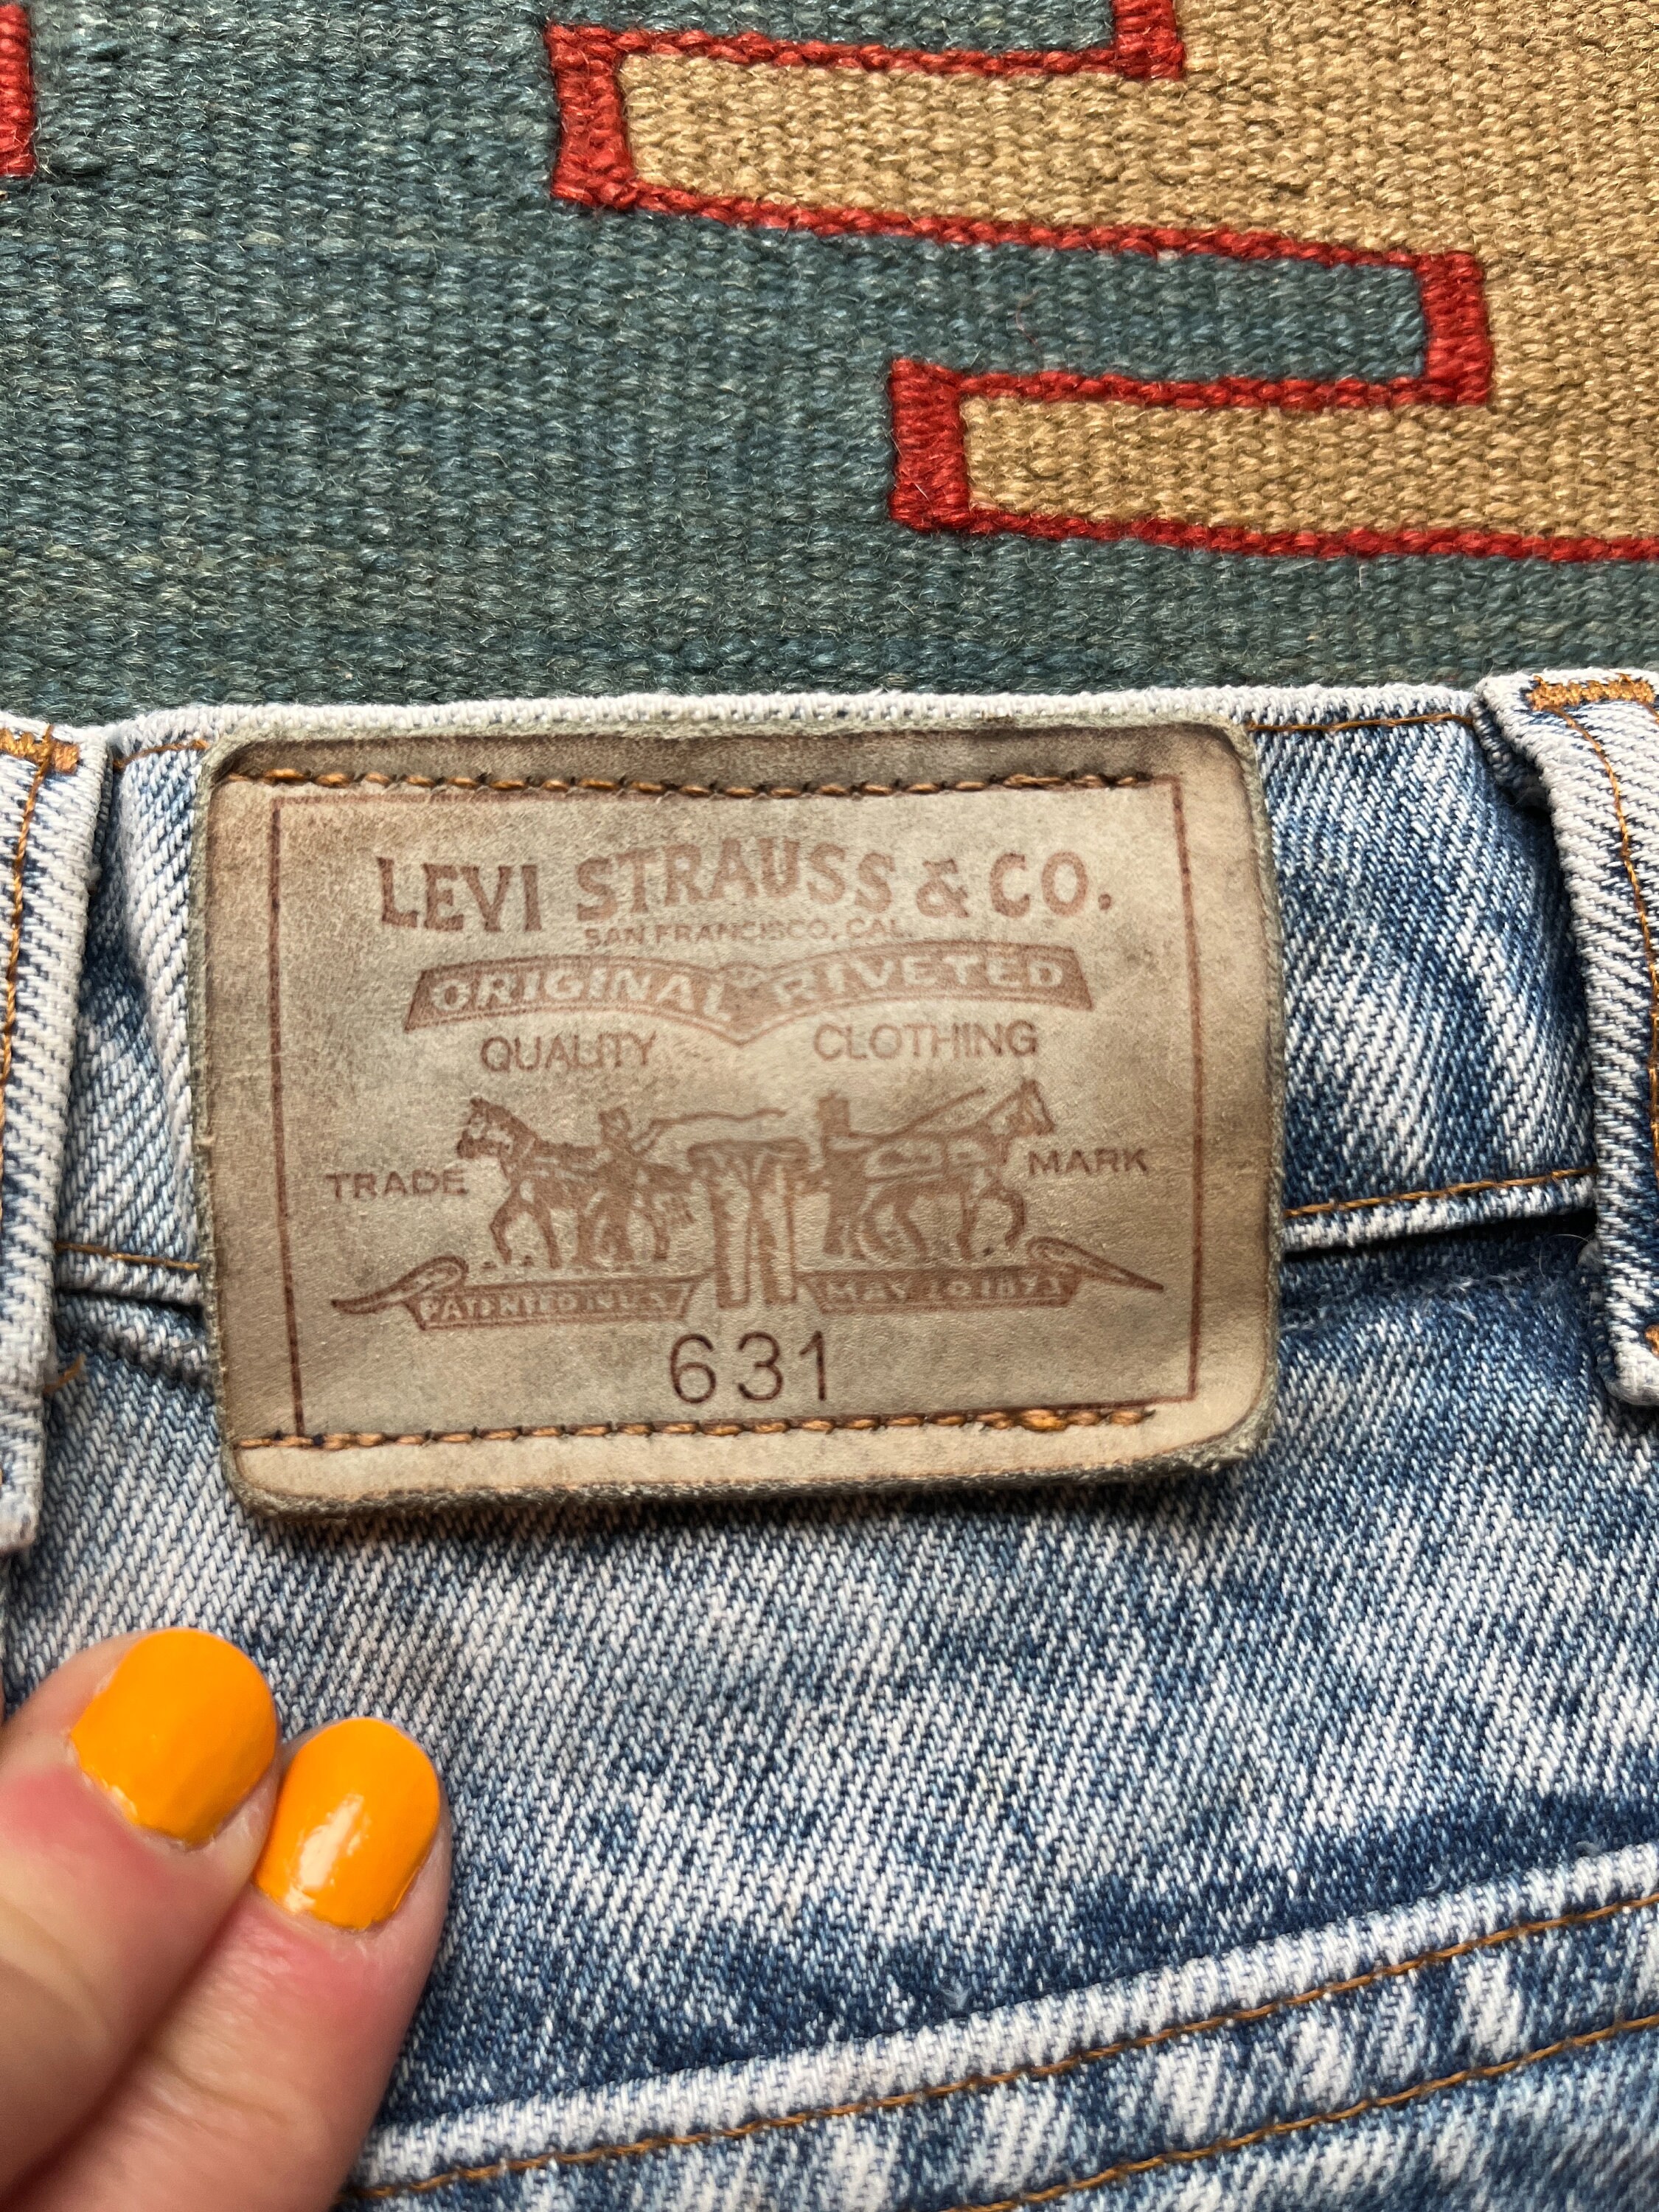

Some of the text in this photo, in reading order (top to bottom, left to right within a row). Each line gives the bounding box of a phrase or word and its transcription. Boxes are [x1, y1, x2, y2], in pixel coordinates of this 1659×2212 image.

[377, 838, 1112, 933] LEVI STRAUSS & CO.
[584, 925, 647, 948] SAN
[431, 955, 1064, 1022] ORIGINAL RIVETED
[480, 1019, 1040, 1072] QUALITY CLOTHING
[325, 1168, 469, 1200] TRADE
[1028, 1147, 1148, 1178] MARK
[669, 1330, 827, 1404] 631
